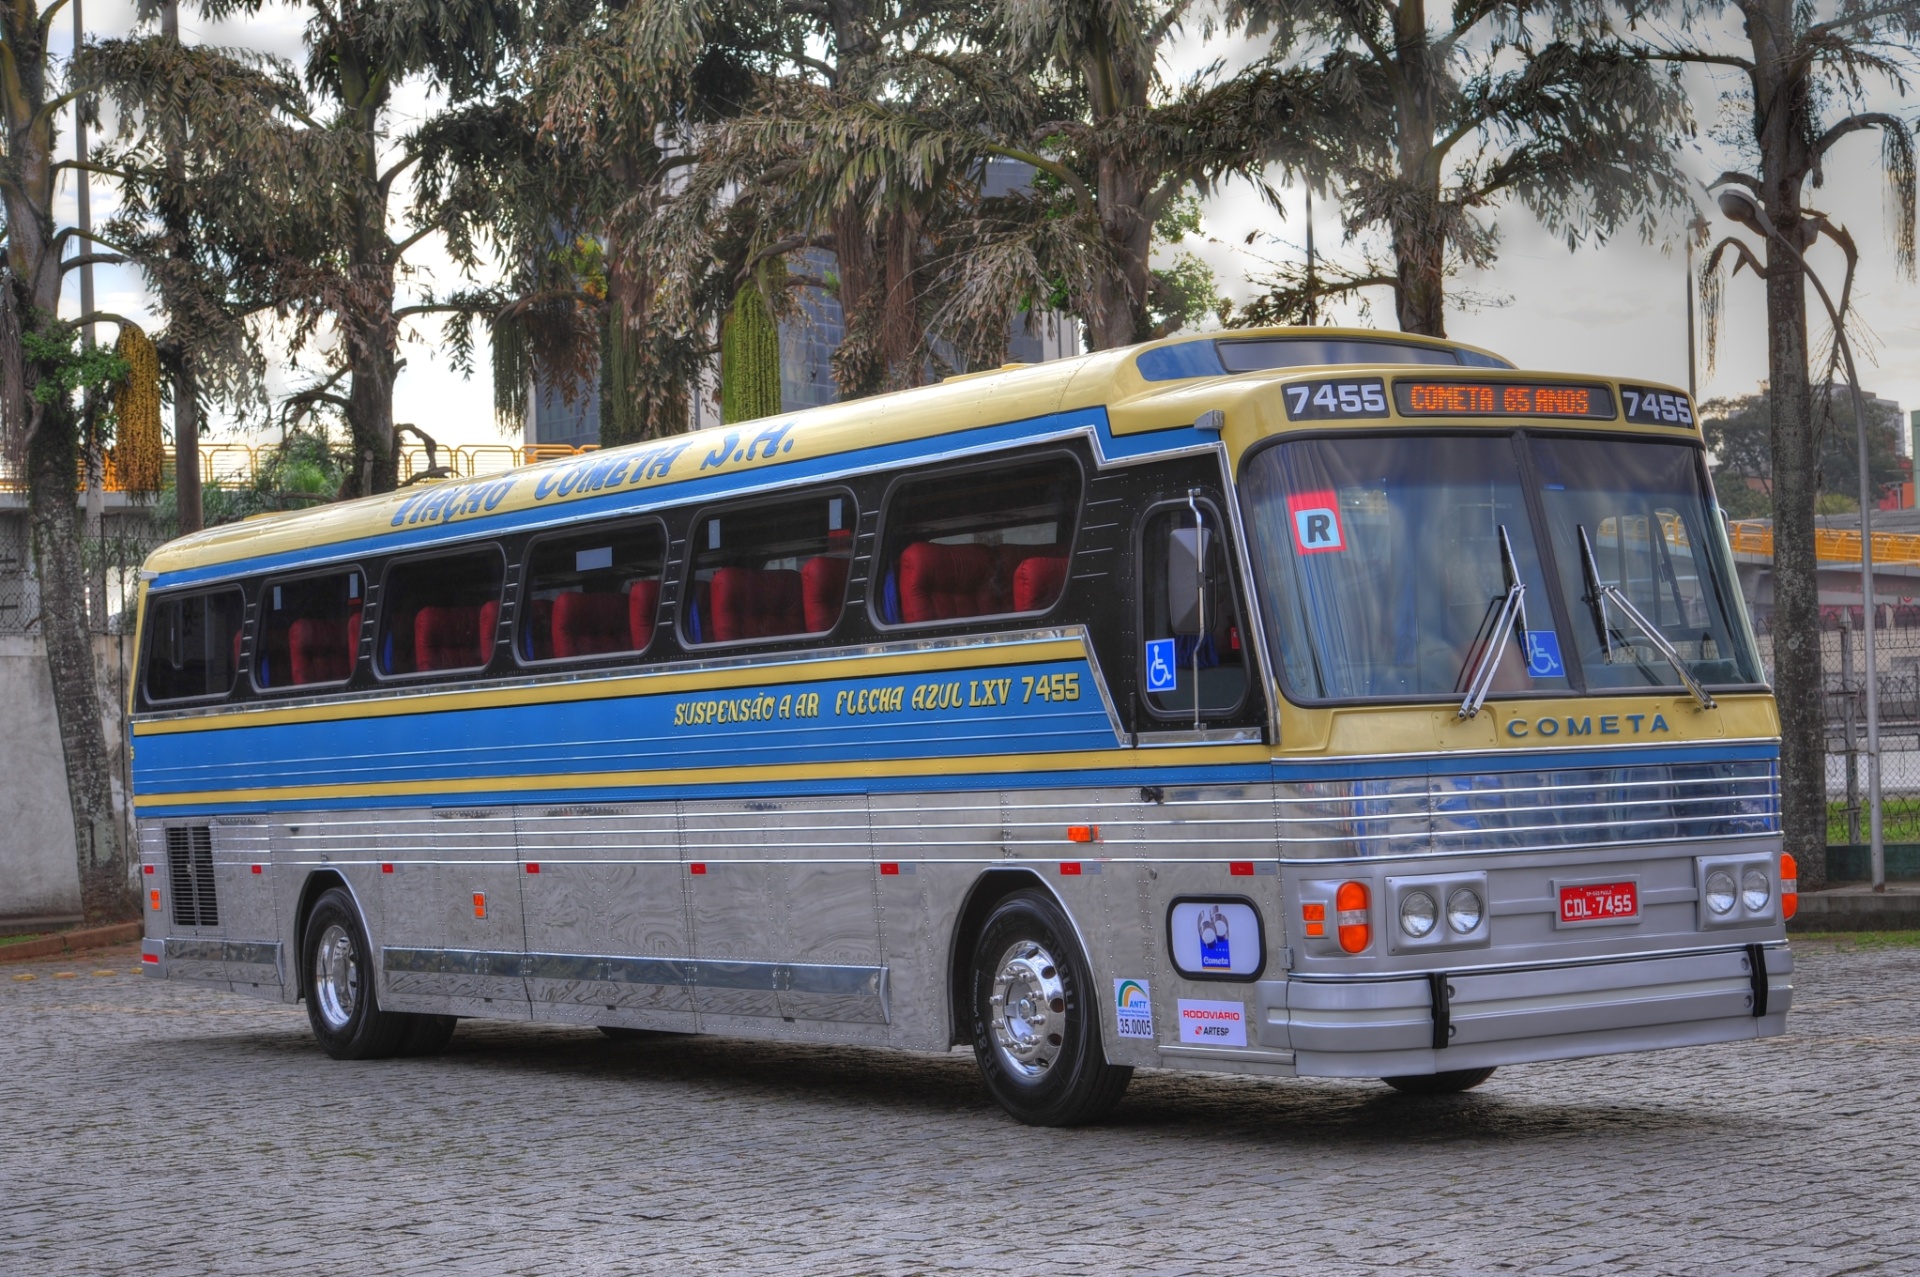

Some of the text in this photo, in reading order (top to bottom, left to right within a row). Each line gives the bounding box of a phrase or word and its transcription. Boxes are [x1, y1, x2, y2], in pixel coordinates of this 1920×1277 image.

[1286, 383, 1386, 414] 7455
[1410, 385, 1589, 414] COMETA 65 ANOS
[1621, 390, 1694, 424] 7455
[534, 440, 694, 500] COMETA
[700, 417, 798, 471] S.A.
[1307, 514, 1331, 543] R
[674, 673, 1081, 726] SUSPENSÃO A AR FLECHA AZUL LXV 7455
[1507, 713, 1670, 737] COMETA
[1203, 956, 1229, 965] Cometa
[1129, 1001, 1147, 1009] ANTT
[1183, 1010, 1240, 1021] RODOVIÁRIO
[1119, 1018, 1152, 1035] 35.0005
[1203, 1026, 1229, 1037] ARTESP
